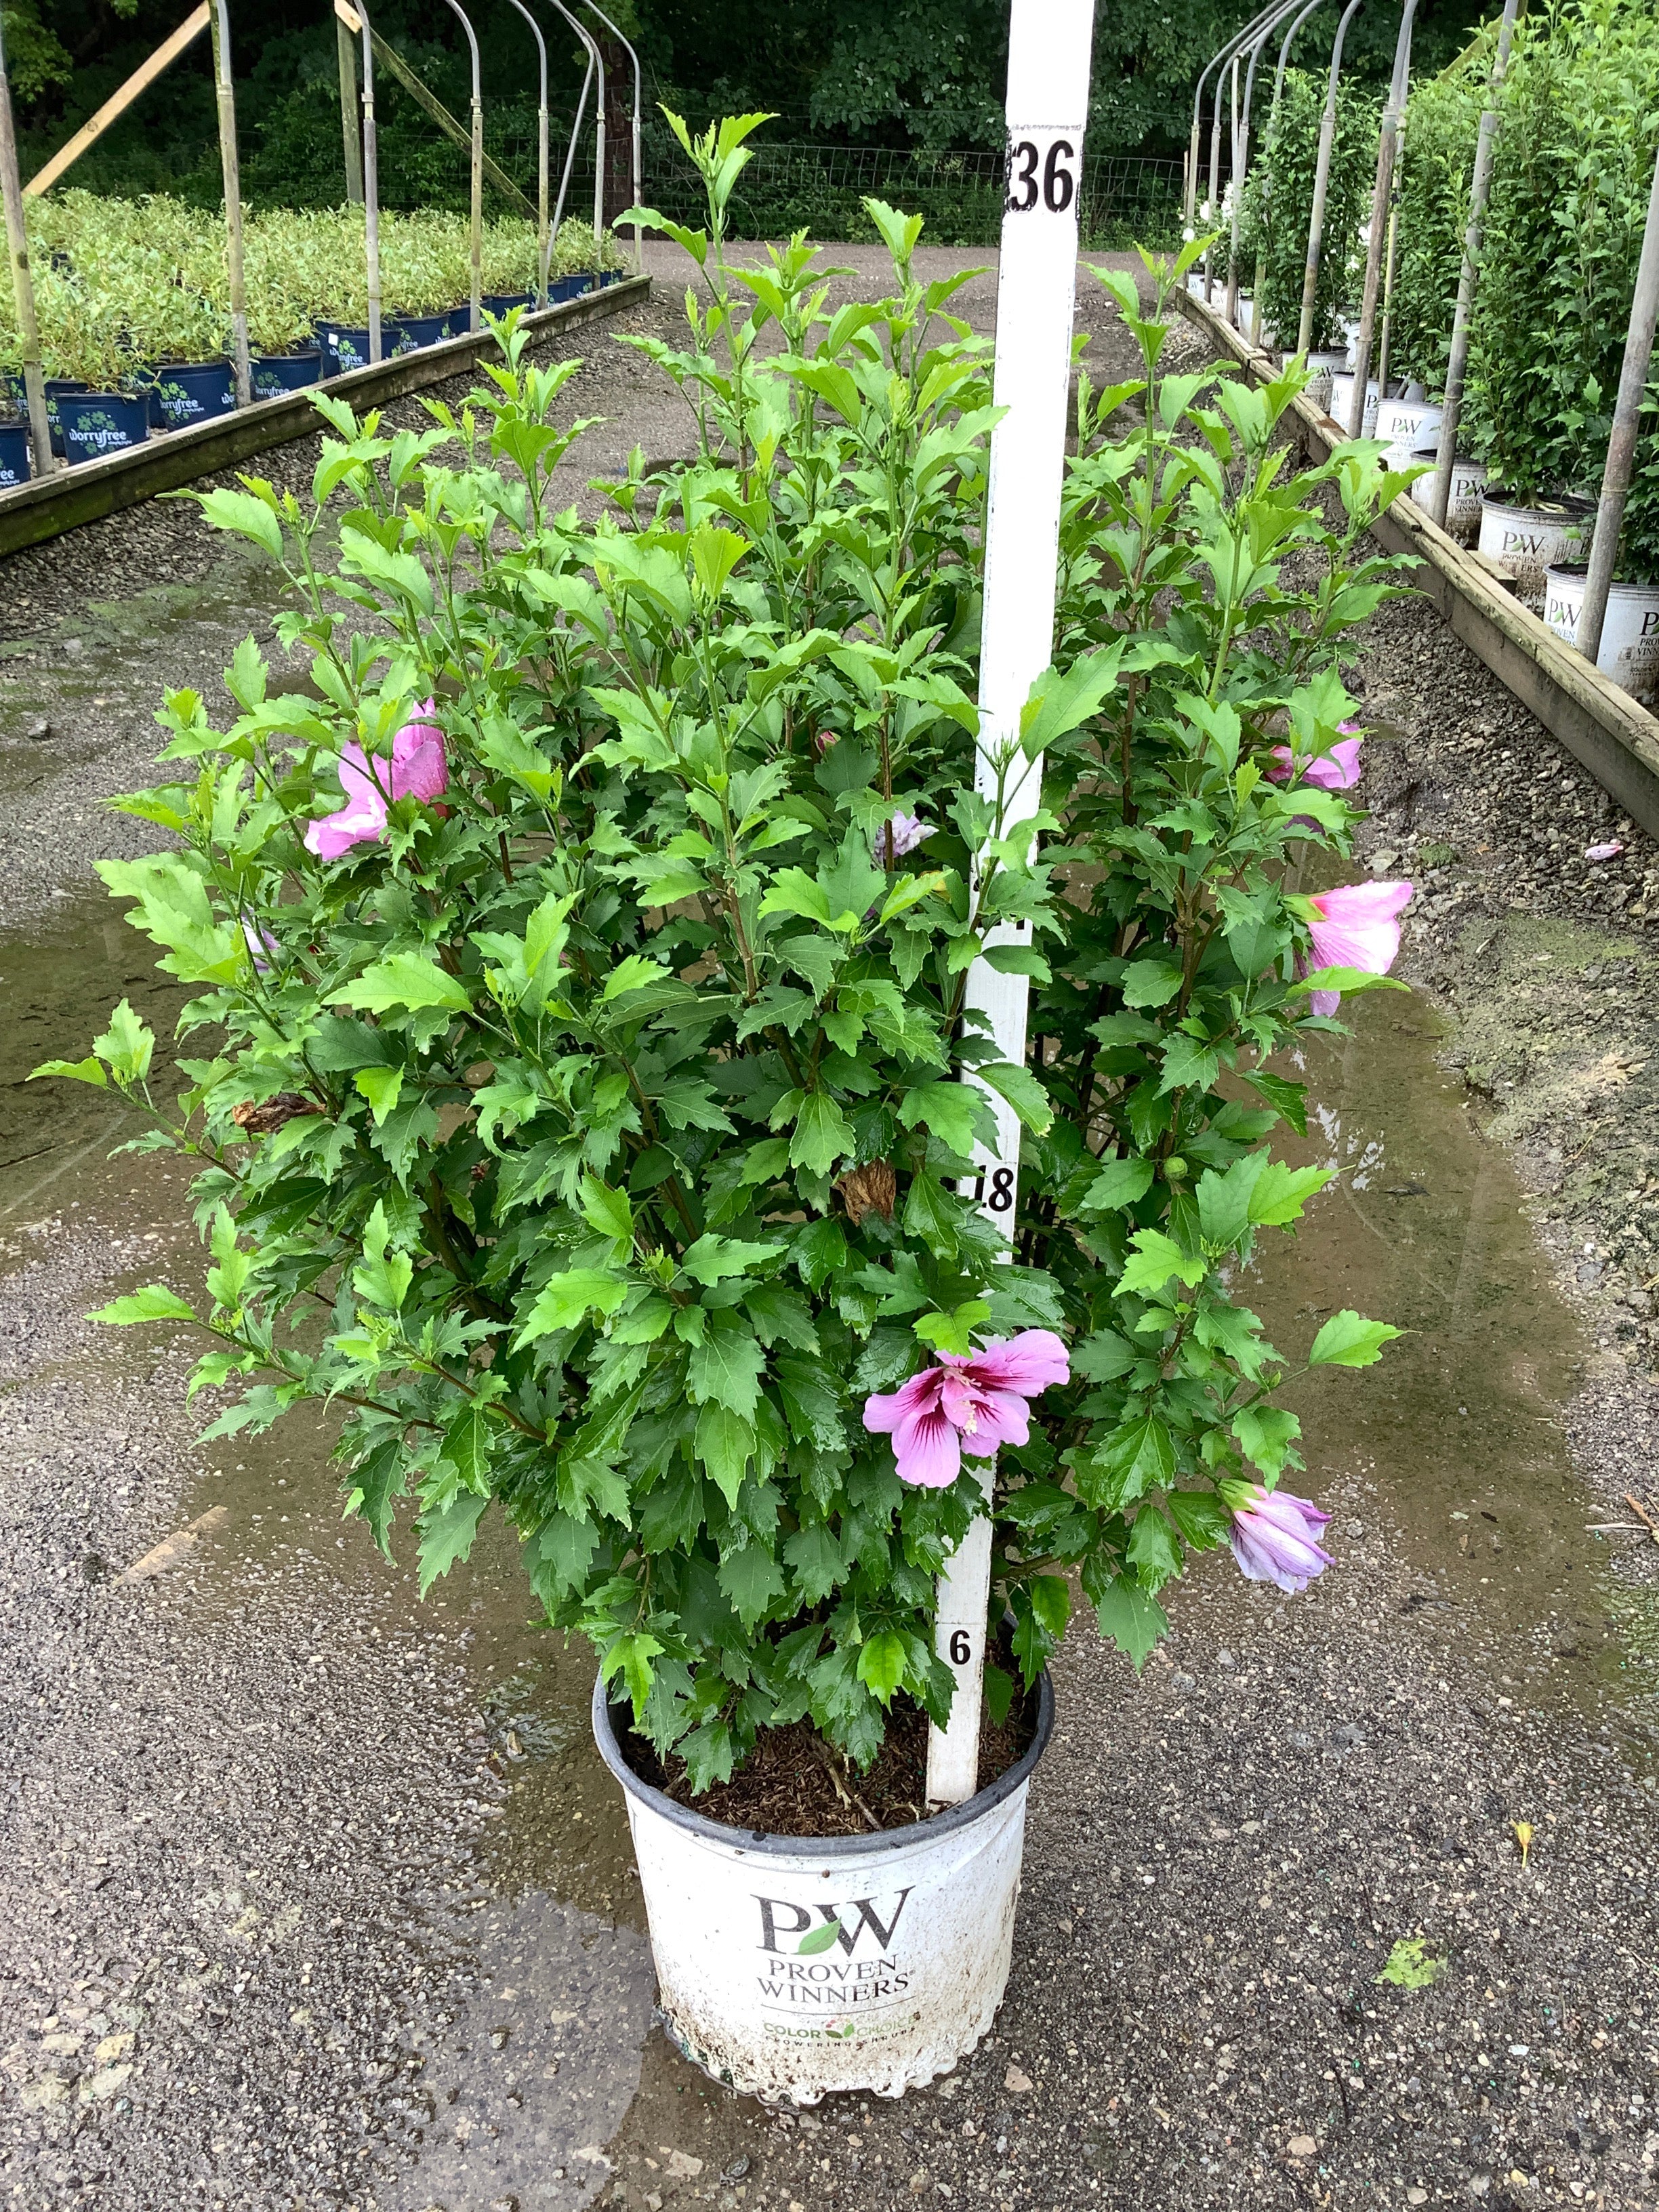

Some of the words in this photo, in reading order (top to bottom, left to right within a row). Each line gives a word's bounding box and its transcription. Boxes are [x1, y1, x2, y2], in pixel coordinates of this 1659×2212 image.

[1010, 140, 1074, 213] 36
[1391, 417, 1422, 434] PW
[1455, 479, 1490, 497] PW
[1502, 531, 1547, 555] PW
[1548, 598, 1582, 628] PW
[974, 1164, 1015, 1212] 18
[949, 1629, 971, 1665] 6
[750, 1885, 916, 1957] PW
[768, 1954, 899, 1982] PROVEN
[764, 2022, 821, 2039] COLOR
[857, 2015, 916, 2037] CHOICE
